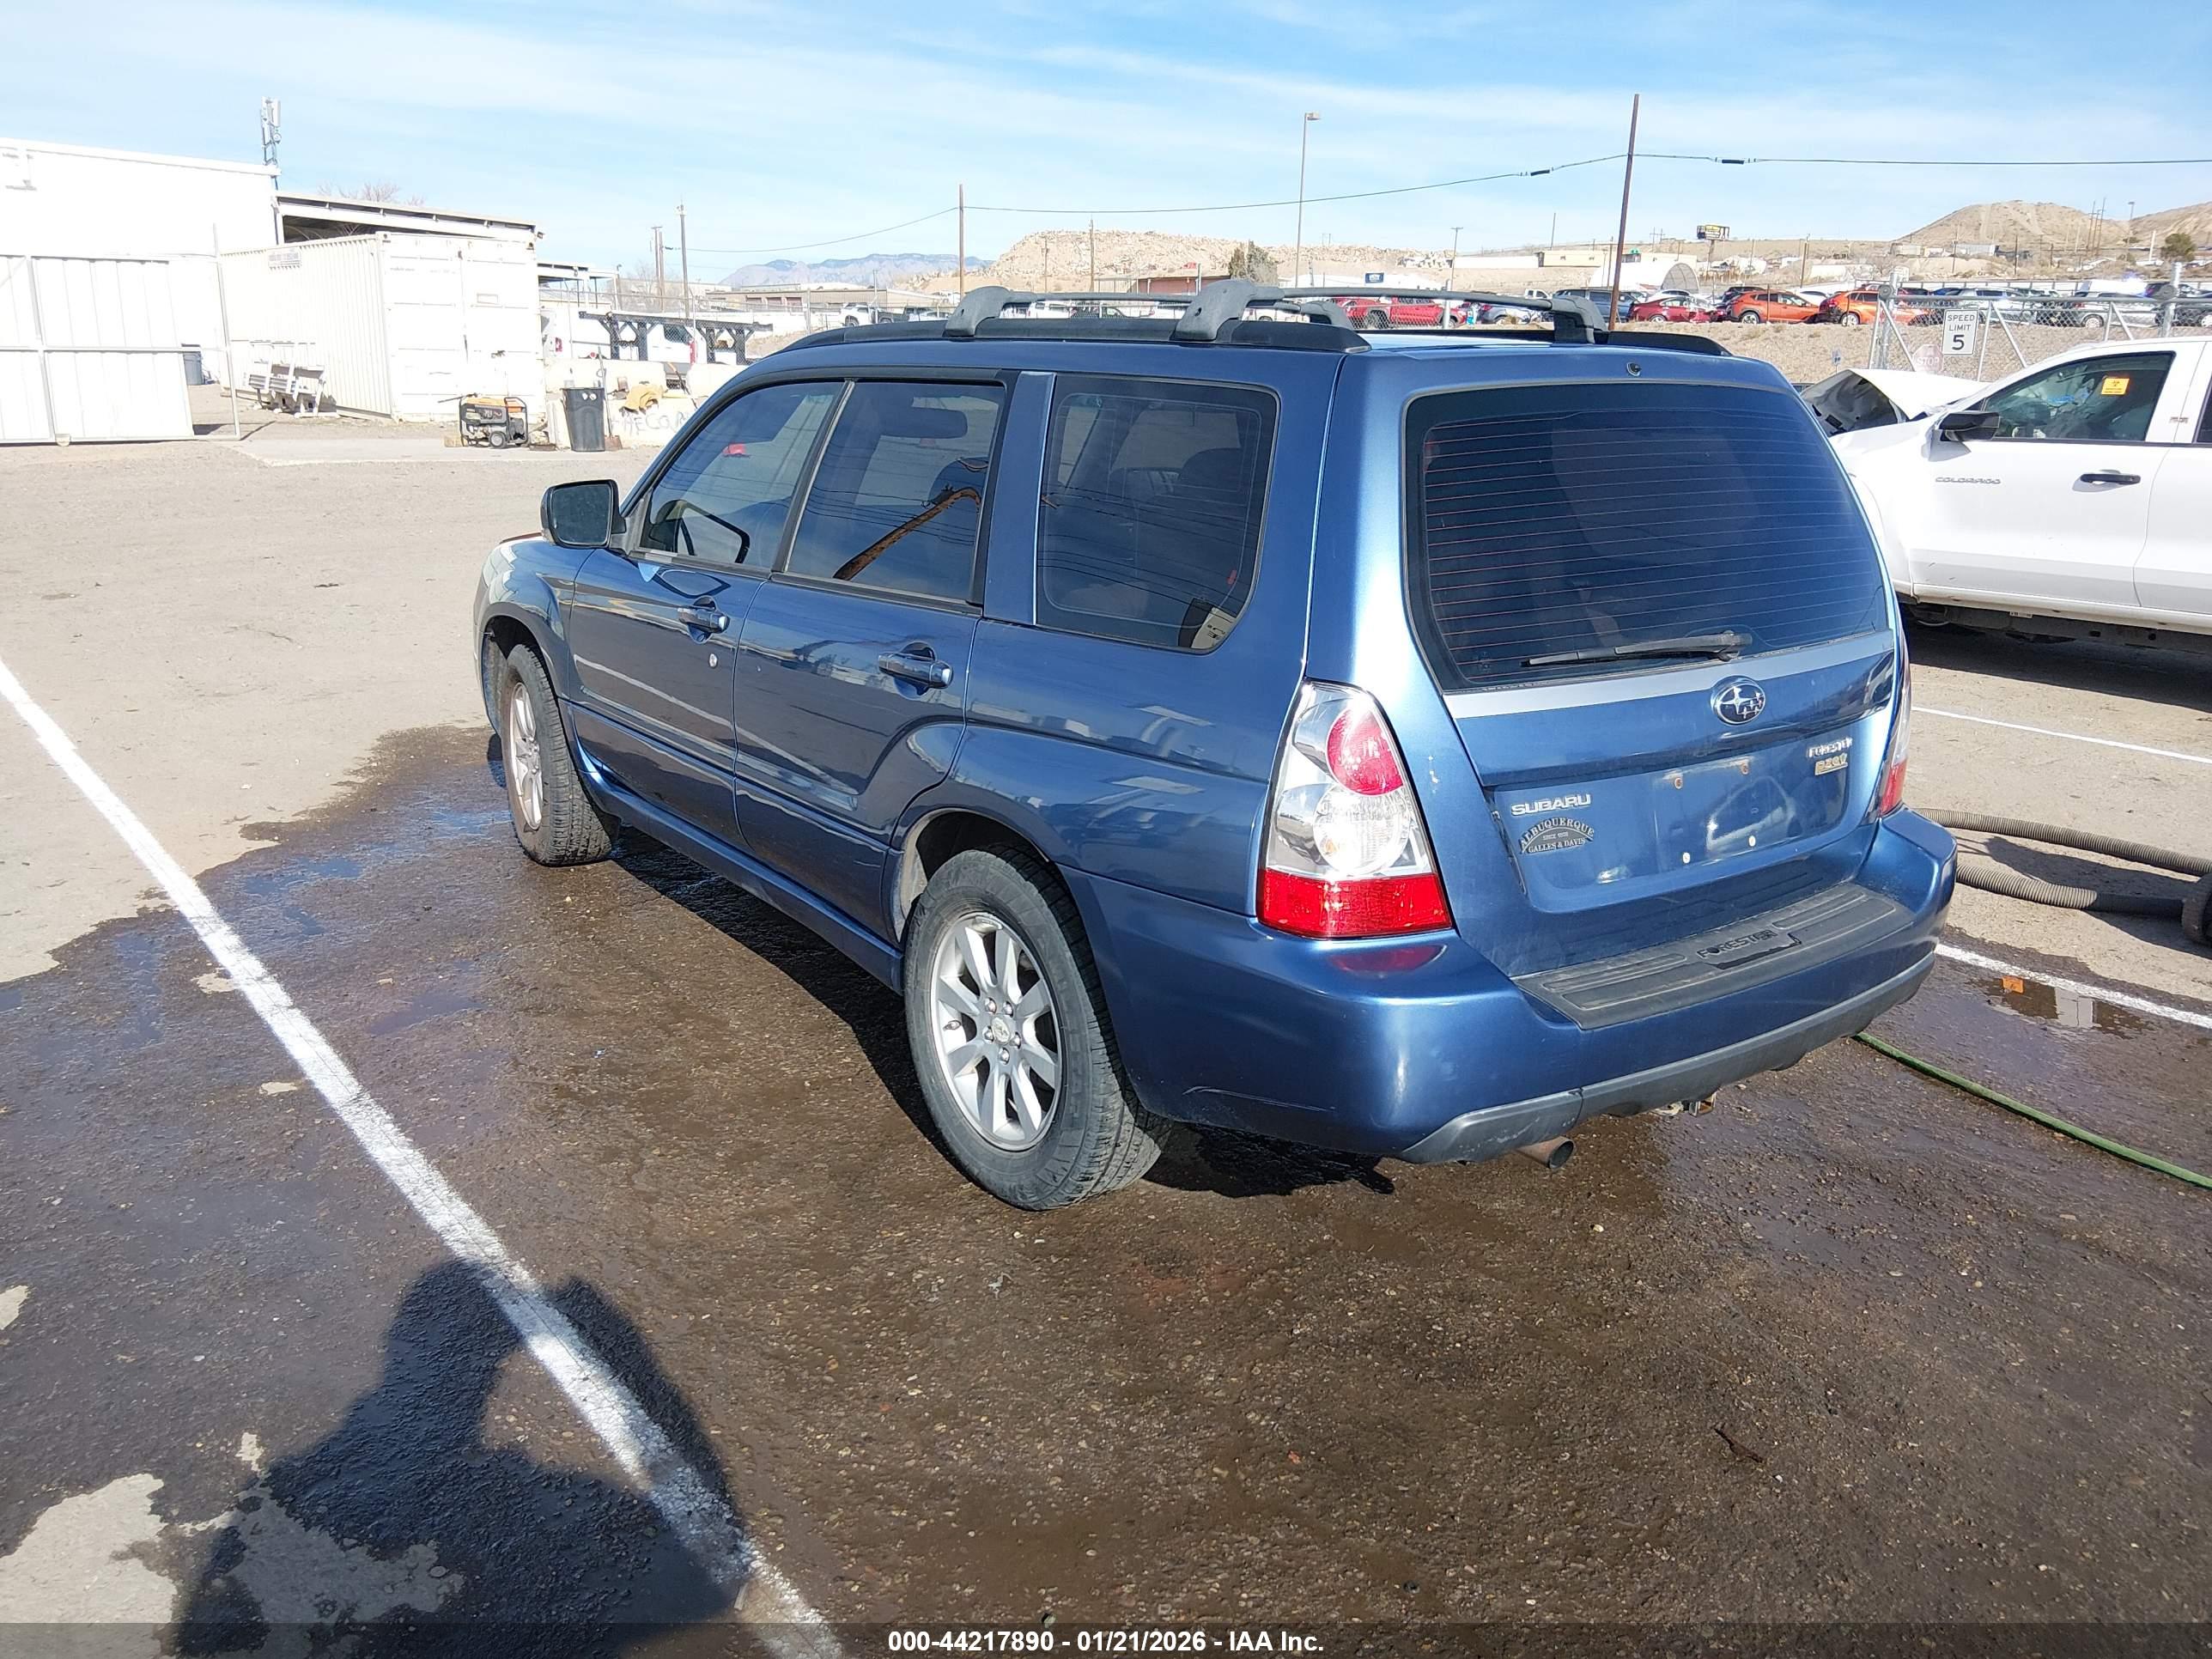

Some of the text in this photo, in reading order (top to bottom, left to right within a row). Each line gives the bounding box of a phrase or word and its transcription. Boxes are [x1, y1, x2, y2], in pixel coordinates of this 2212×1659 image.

[1951, 334, 1966, 350] 5
[1917, 356, 1940, 365] STOP
[1510, 793, 1592, 817] SUBARU
[1519, 817, 1595, 850] ALBUQUERQUE
[1528, 842, 1557, 854] GALLES
[1565, 837, 1587, 848] DAVIS
